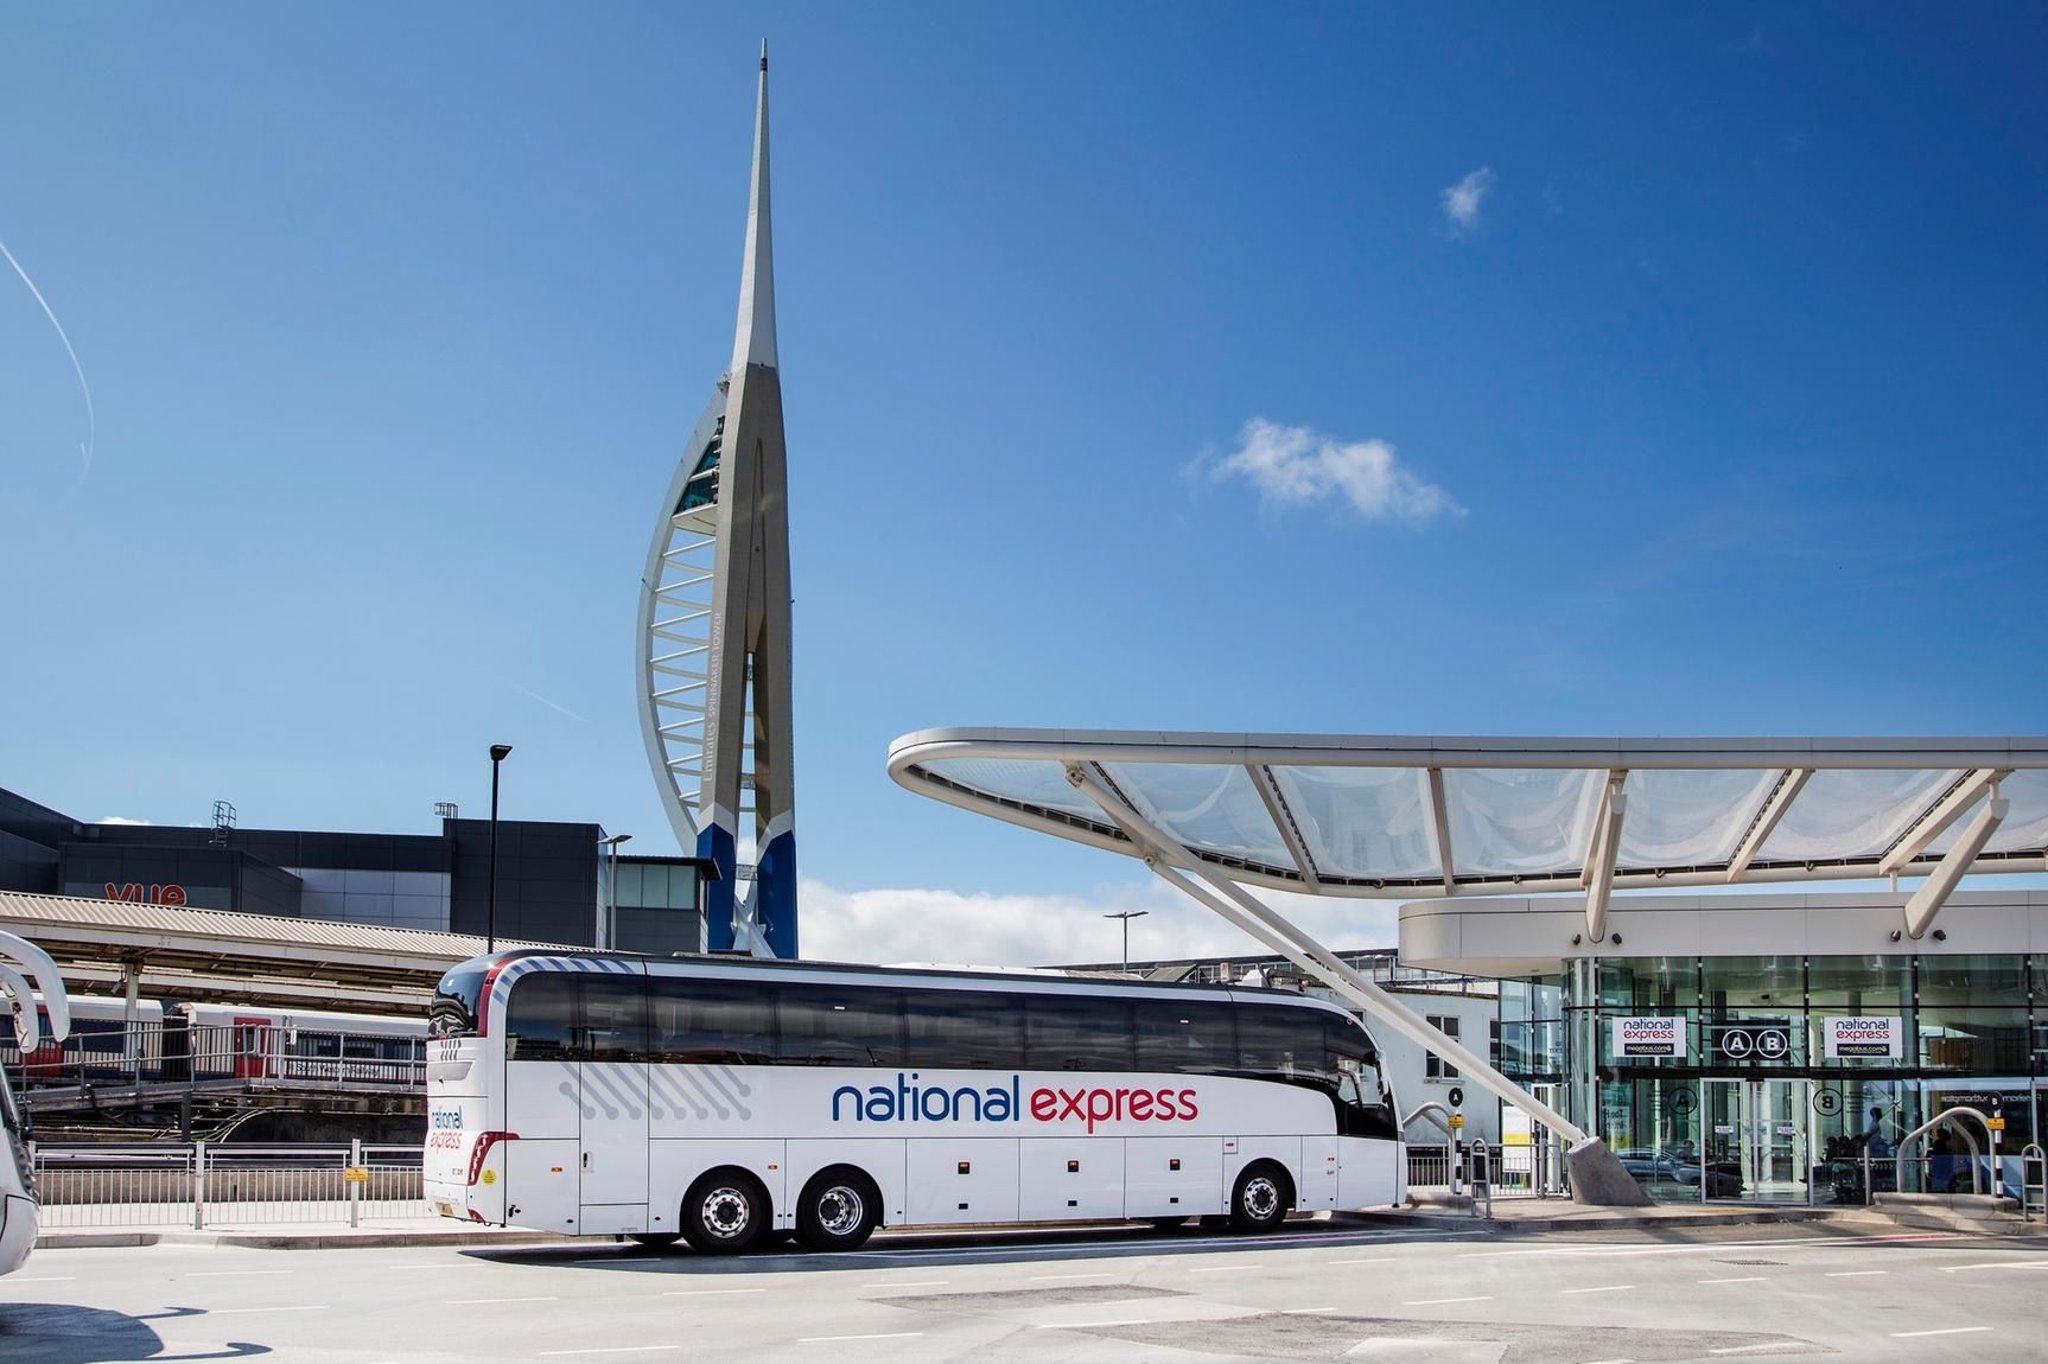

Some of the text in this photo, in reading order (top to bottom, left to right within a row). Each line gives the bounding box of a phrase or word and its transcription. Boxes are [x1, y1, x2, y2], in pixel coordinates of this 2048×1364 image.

[1624, 1019, 1674, 1029] national
[1836, 1018, 1889, 1029] national
[1624, 1030, 1674, 1041] express
[1836, 1030, 1889, 1041] express
[1730, 1037, 1779, 1050] A B
[832, 1072, 1198, 1134] national express
[431, 1105, 463, 1129] national
[429, 1132, 463, 1154] express
